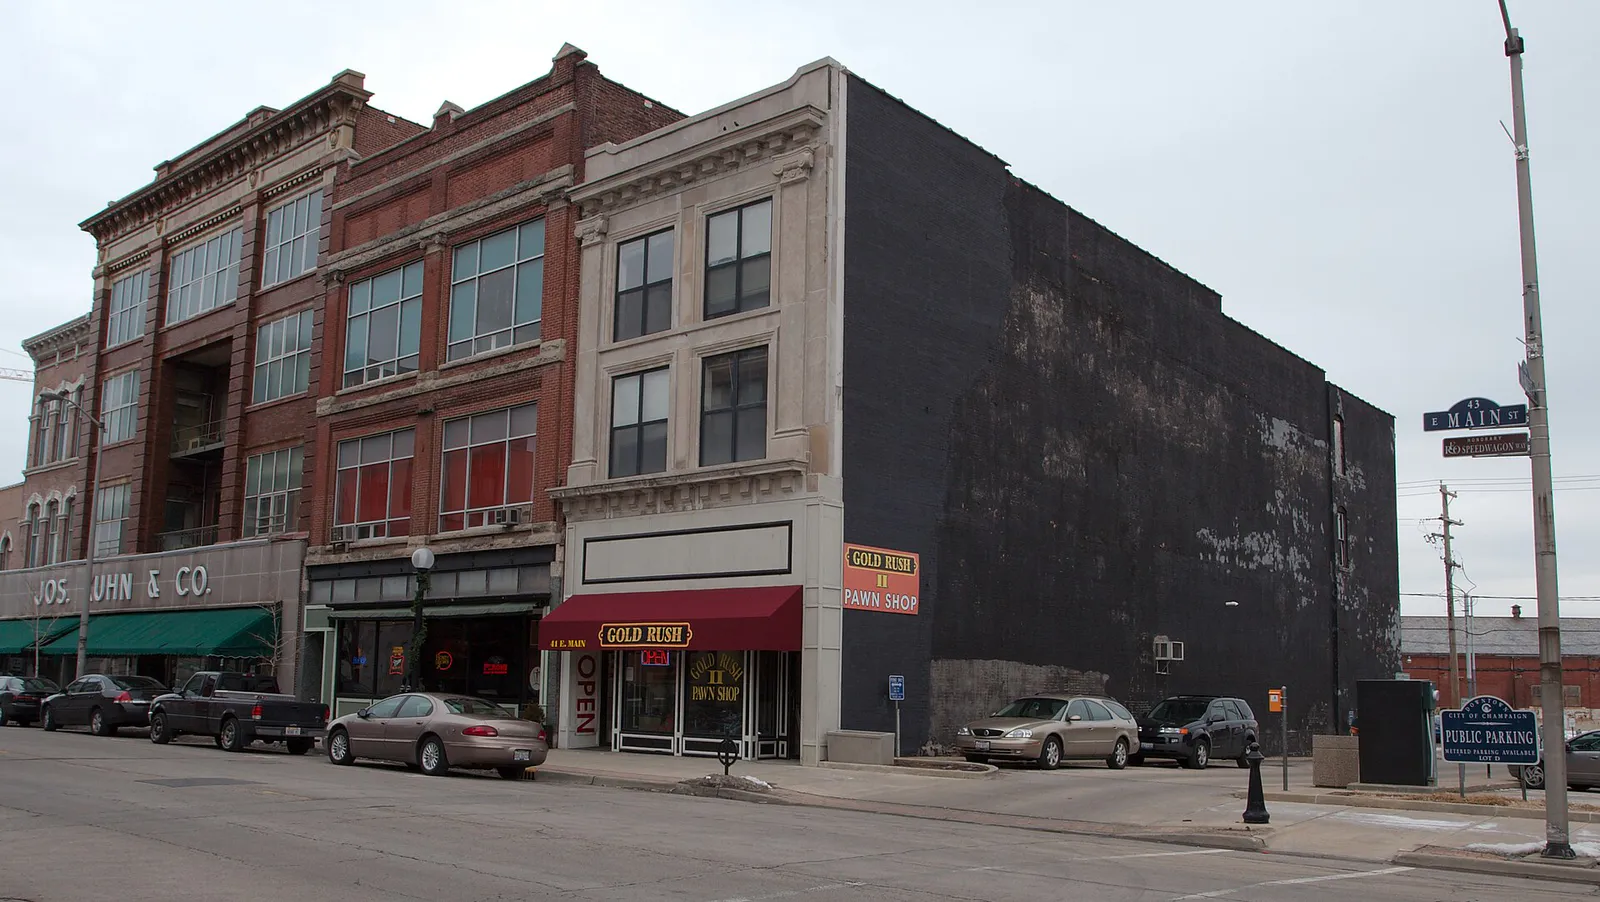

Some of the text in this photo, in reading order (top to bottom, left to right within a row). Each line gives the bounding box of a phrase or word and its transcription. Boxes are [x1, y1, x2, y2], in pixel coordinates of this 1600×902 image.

[1468, 400, 1480, 409] 43
[1432, 409, 1519, 428] E MAIN ST
[1461, 442, 1515, 454] SPEEDWAGON
[853, 551, 911, 571] GOLD RUSH
[34, 565, 212, 606] JOS. UHN & CO.
[877, 574, 887, 587] II
[844, 589, 917, 611] PAWN SHOP
[607, 626, 682, 643] GOLD RUSH
[550, 640, 586, 648] 41 E. MAIN
[642, 649, 669, 665] OPEN
[690, 652, 744, 681] GOLD RUSH
[707, 670, 724, 685] II
[576, 654, 596, 734] OPEN
[692, 686, 740, 702] PAWN SHOP
[1465, 698, 1509, 712] DOWNTOWN
[1445, 729, 1533, 745] PUBLIC PARKING
